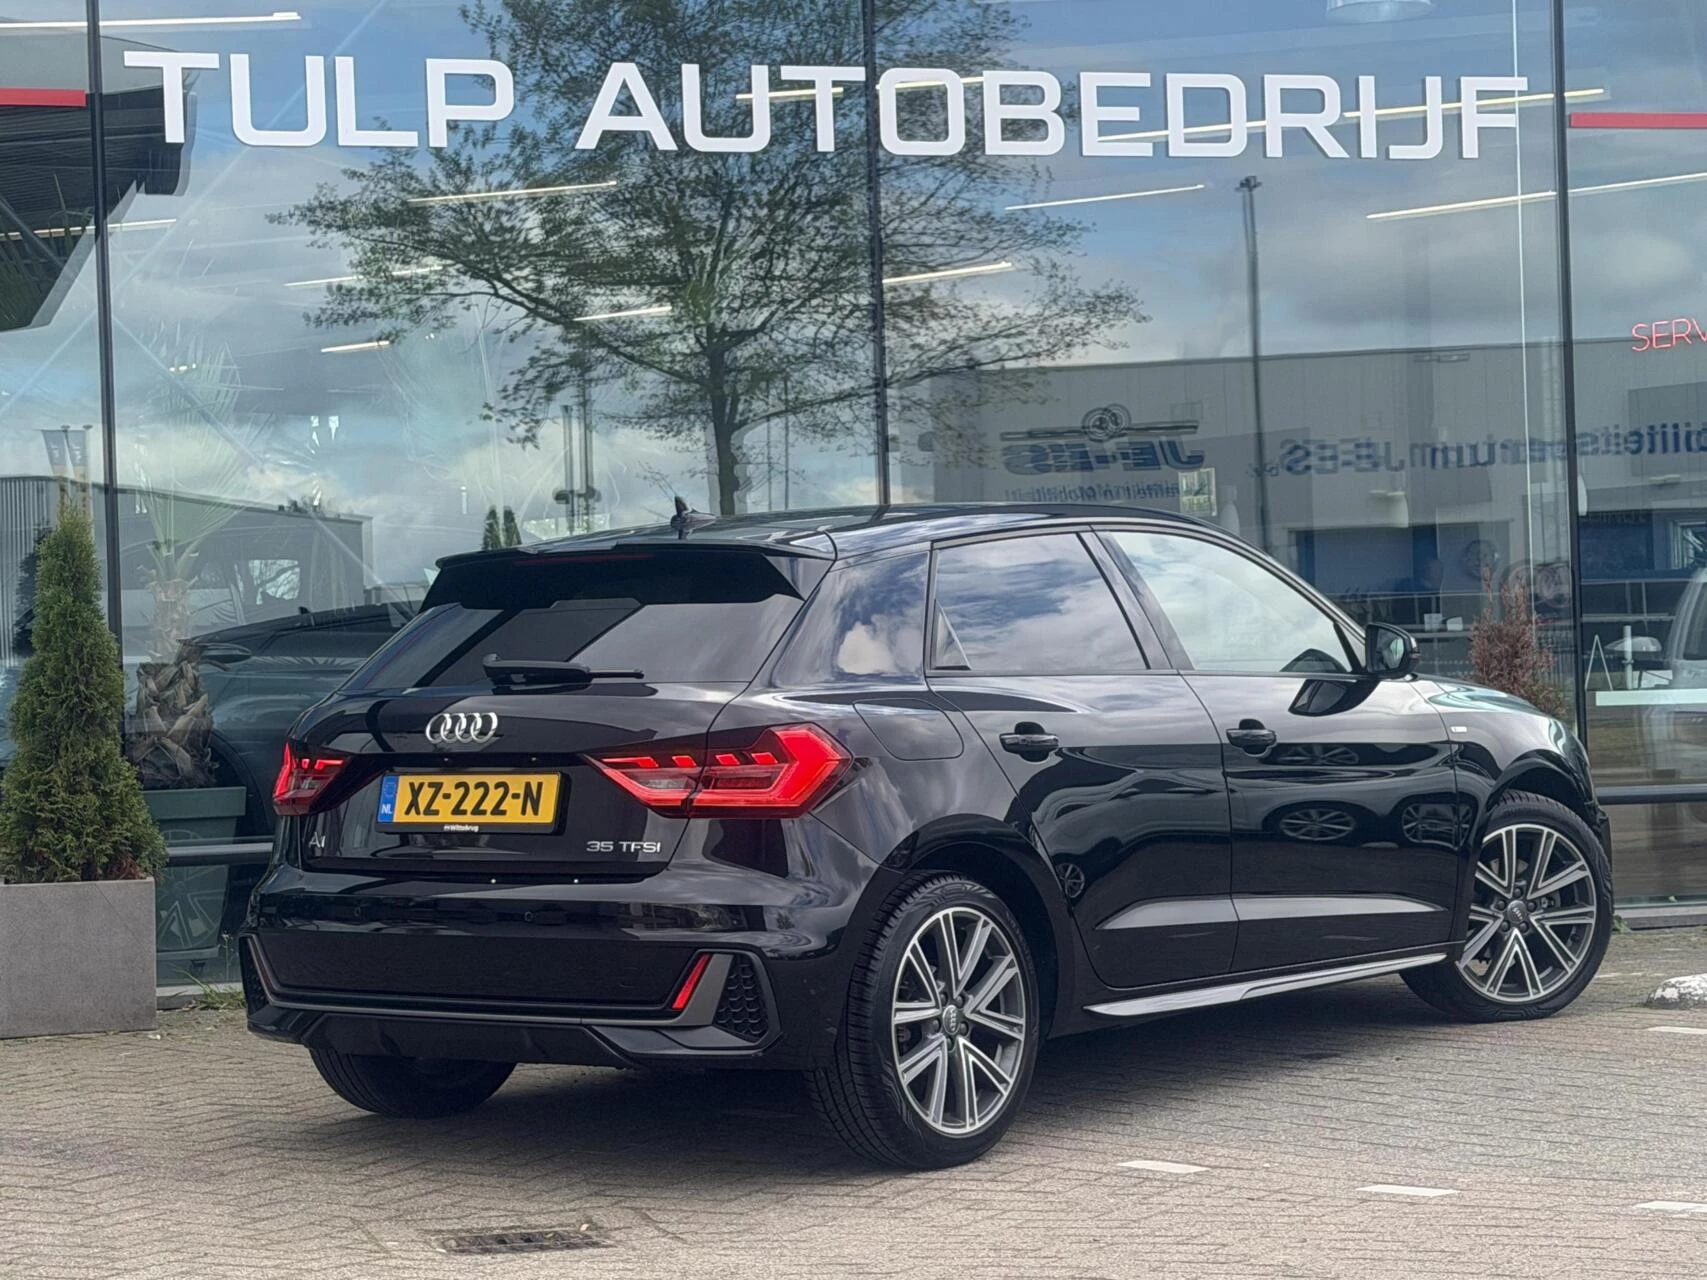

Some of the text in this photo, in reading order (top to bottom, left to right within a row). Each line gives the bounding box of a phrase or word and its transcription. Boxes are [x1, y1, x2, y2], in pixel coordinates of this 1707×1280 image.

[123, 50, 1528, 160] TULP AUTOBEDRIJF
[381, 803, 393, 815] NL
[404, 781, 544, 816] XZ-222-N
[586, 840, 662, 853] 35 TFSI
